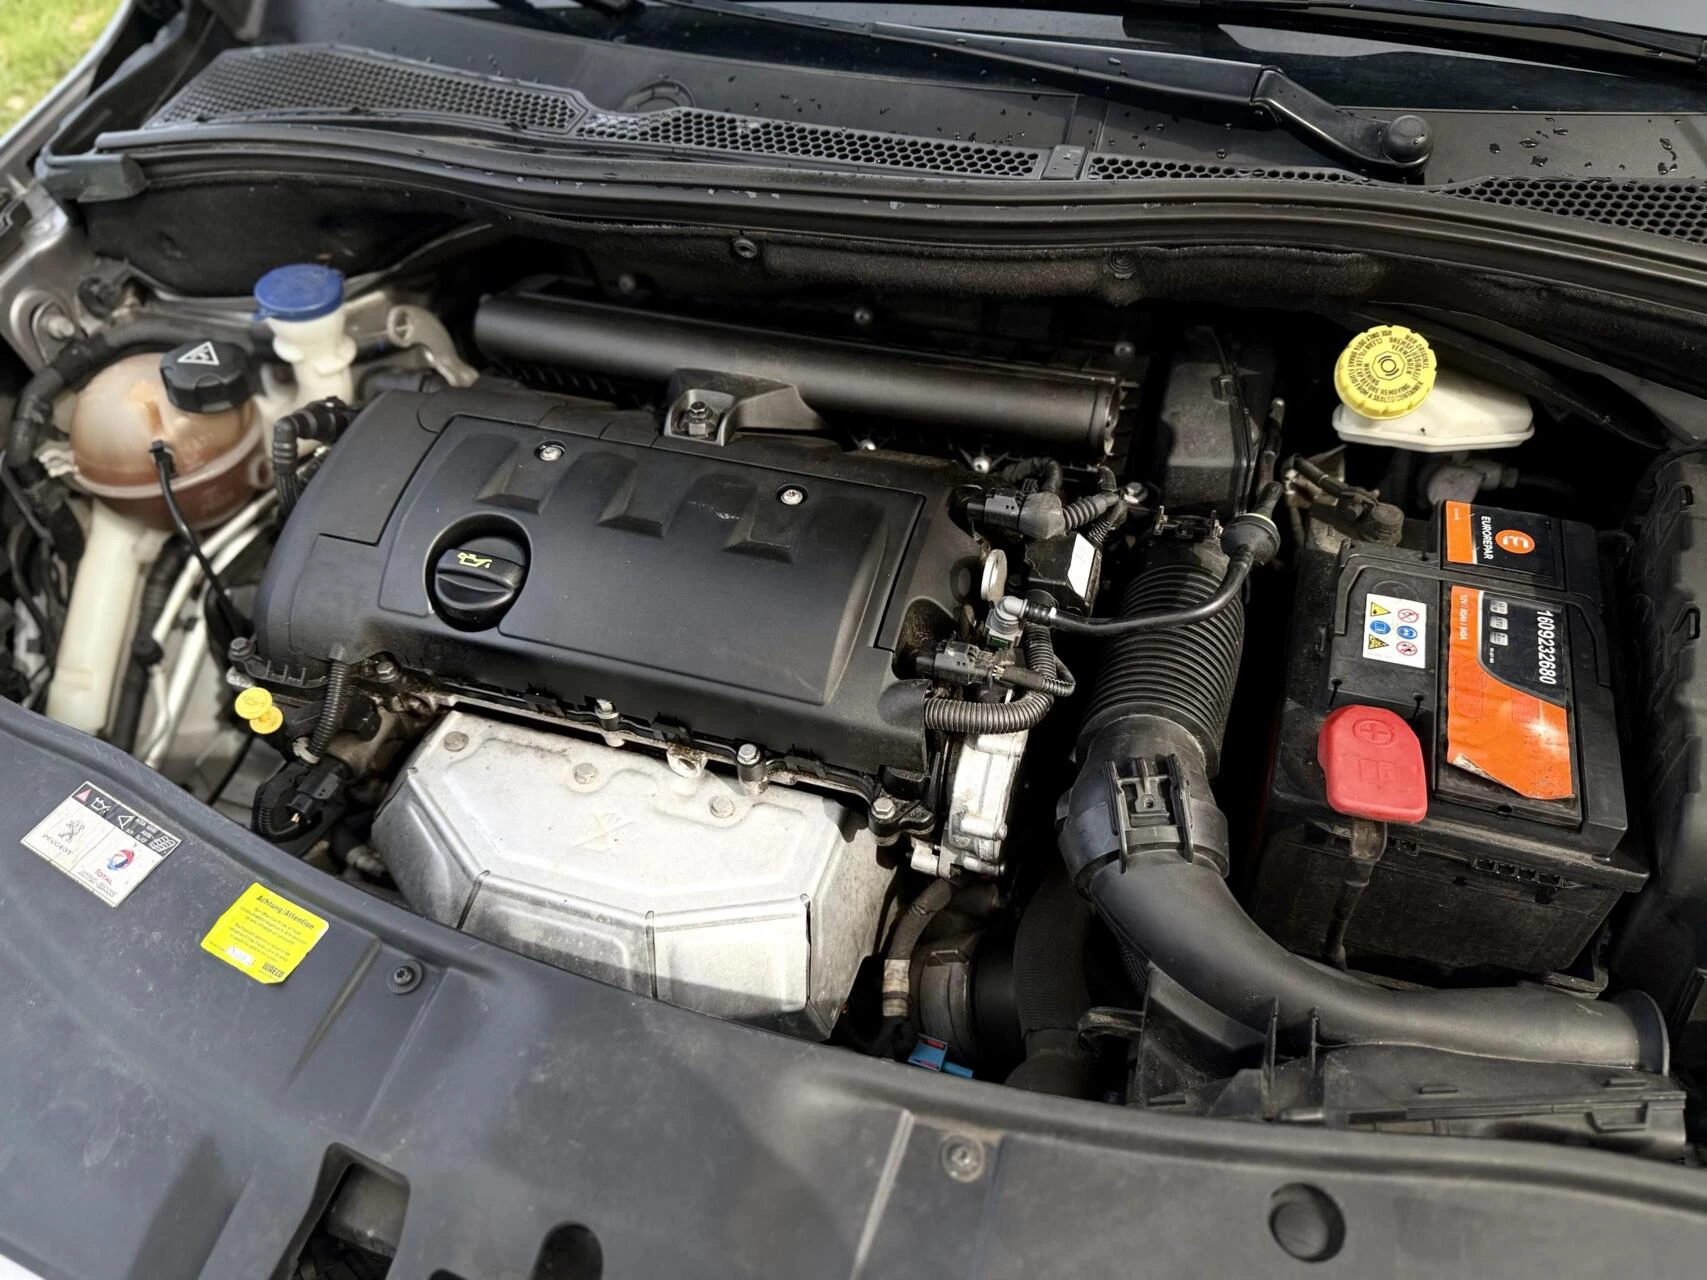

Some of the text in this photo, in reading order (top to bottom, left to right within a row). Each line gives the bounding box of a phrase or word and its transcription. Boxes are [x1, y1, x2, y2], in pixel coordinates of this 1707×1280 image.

[1364, 338, 1383, 350] CLEAN
[1405, 334, 1429, 369] NUR ORIGINAL
[1391, 344, 1415, 375] VERWENDEN
[1356, 367, 1365, 377] CAP
[1363, 363, 1380, 386] WARNING
[1481, 515, 1495, 560] EUROREPAR
[1536, 610, 1558, 685] 1609232680
[42, 833, 72, 855] PEUGEOT
[95, 868, 113, 886] TOTAL
